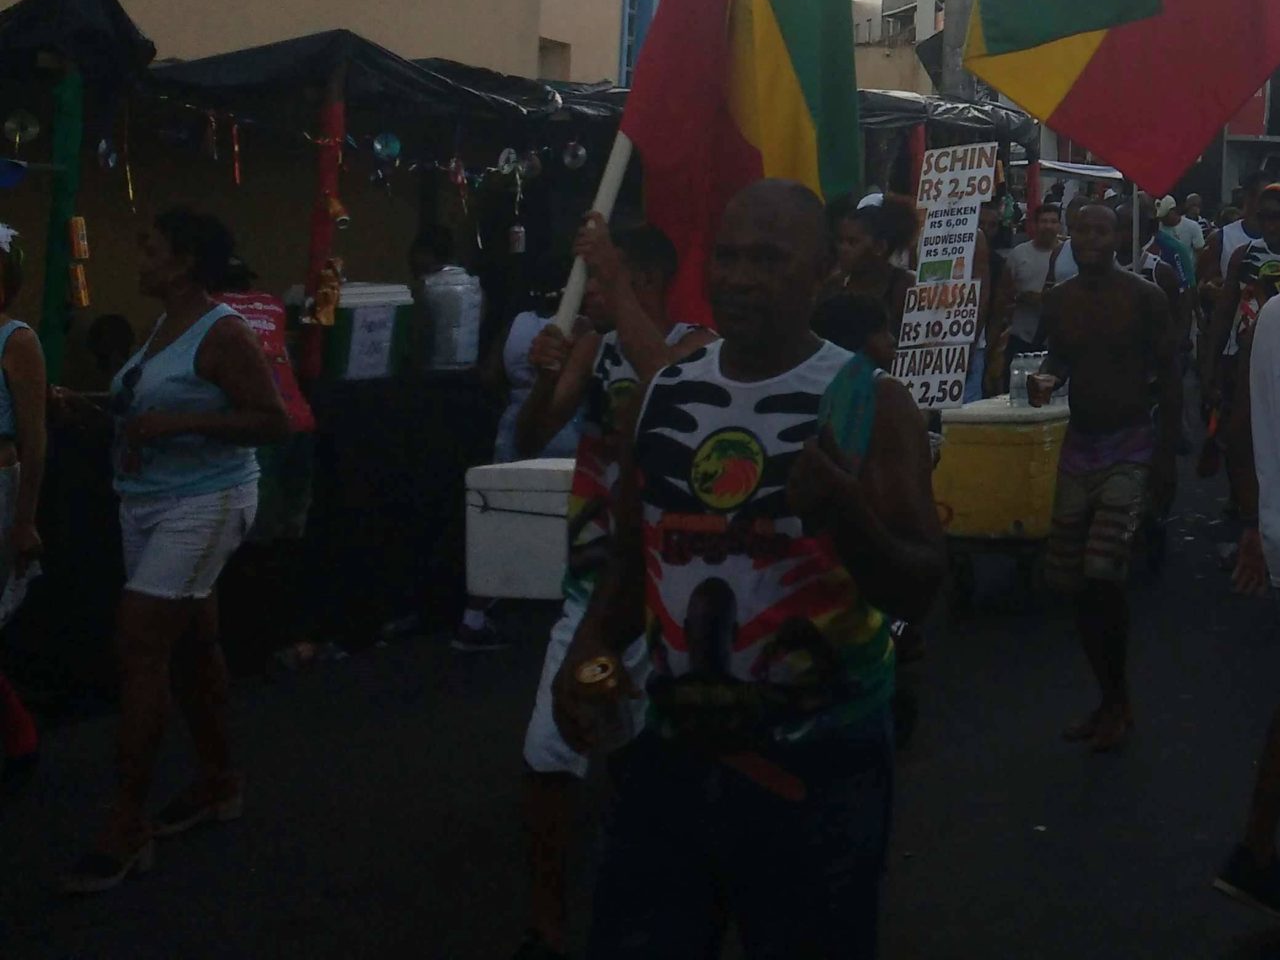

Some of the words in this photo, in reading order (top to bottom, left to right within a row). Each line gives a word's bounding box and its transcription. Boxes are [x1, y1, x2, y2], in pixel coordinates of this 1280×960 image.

[923, 146, 997, 176] SCHIN
[918, 178, 943, 202] R$
[947, 175, 992, 201] 2,50
[928, 206, 977, 219] HEINEKEN
[930, 220, 943, 229] R$
[945, 218, 968, 228] 6,00
[923, 233, 974, 247] BUDWEISER
[925, 248, 938, 257] R$
[942, 246, 965, 256] 5,00
[905, 283, 977, 314] DEVASSA
[954, 309, 975, 319] POR
[900, 321, 921, 342] R$
[925, 319, 975, 340] 10,00
[892, 346, 966, 377] ITAIPAVA
[918, 379, 963, 406] 2,50
